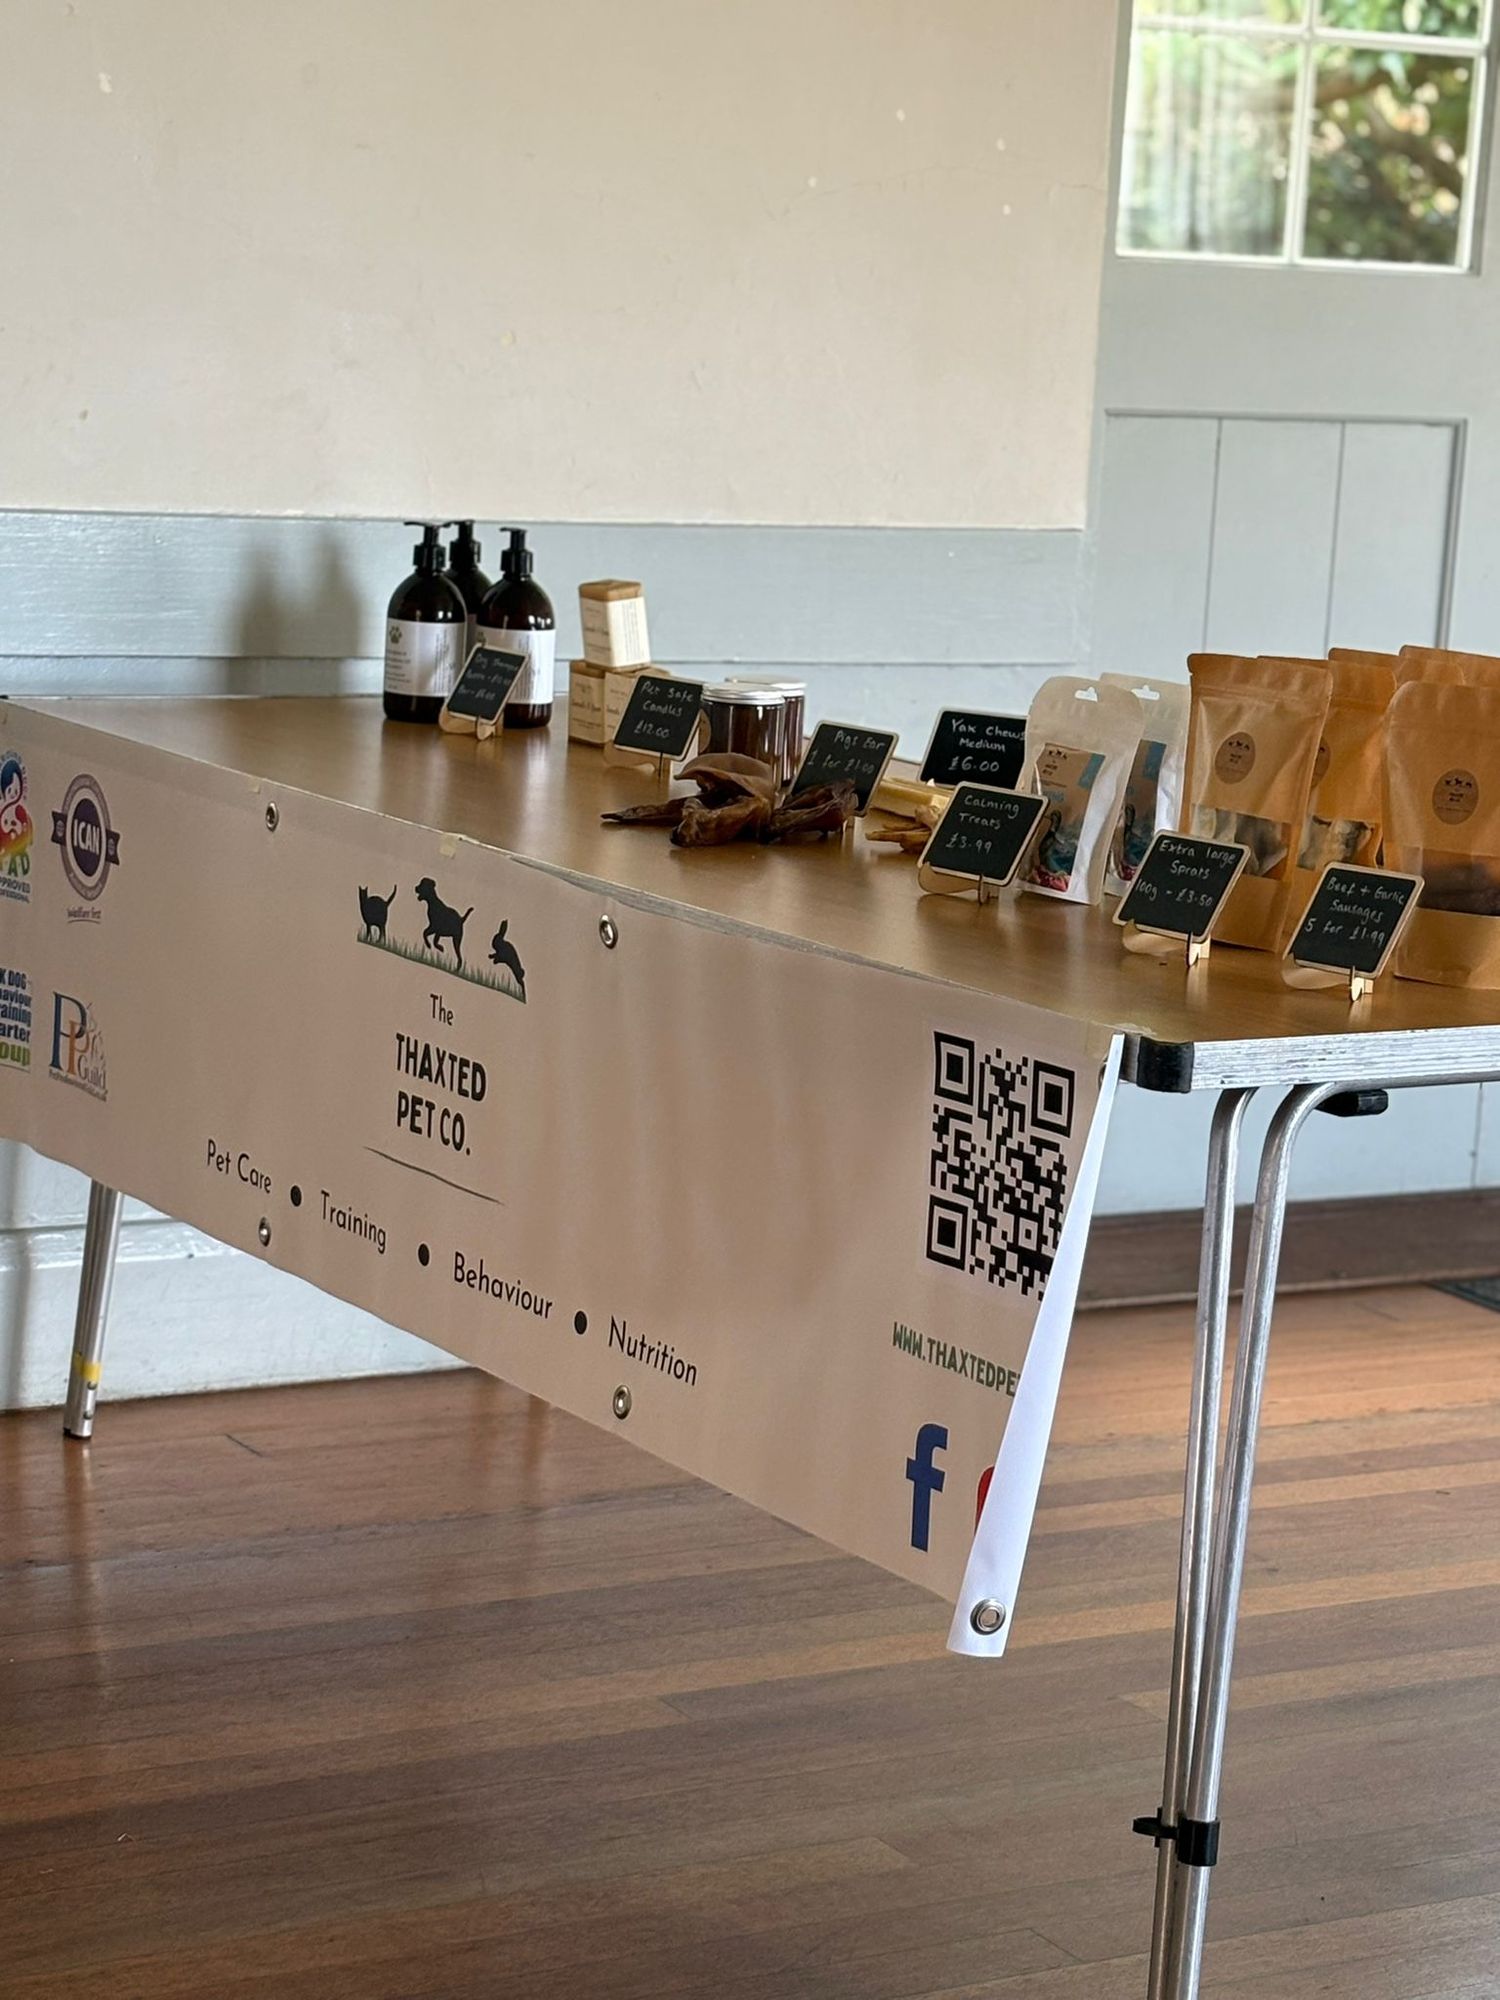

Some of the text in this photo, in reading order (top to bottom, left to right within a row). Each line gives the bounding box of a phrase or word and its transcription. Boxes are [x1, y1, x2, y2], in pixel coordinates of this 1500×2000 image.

[640, 680, 693, 702] Pet Safe
[643, 700, 683, 717] Candles
[634, 720, 670, 738] £12.00
[834, 729, 886, 750] Pigs Ear
[985, 725, 1025, 741] Chews
[959, 737, 1006, 752] Medium
[807, 749, 818, 766] 1
[822, 753, 841, 768] for
[948, 755, 1000, 772] £6.00
[964, 794, 1019, 819] Calming
[959, 812, 1001, 830] Treats
[74, 818, 101, 855] ICAN
[945, 832, 993, 854] £3.99
[1159, 839, 1195, 857] Extra
[1170, 859, 1210, 880] Sprats
[1135, 878, 1158, 901] 100g
[1175, 887, 1213, 907] £3.50
[1326, 876, 1405, 905] Beef + Garlic
[1329, 898, 1384, 925] Sausages
[1304, 917, 1385, 948] 5 for £1.99
[8, 969, 27, 990] DOG
[0, 987, 31, 1008] aviour
[0, 1003, 31, 1028] aining
[430, 993, 454, 1026] The
[78, 1054, 106, 1090] Guild
[396, 1032, 487, 1102] THAXTED
[397, 1090, 471, 1156] PET CO.
[207, 1139, 697, 1387] Pet Care Training Behaviour Nutrition
[892, 1321, 1021, 1398] WWW.THAXTEDPE
